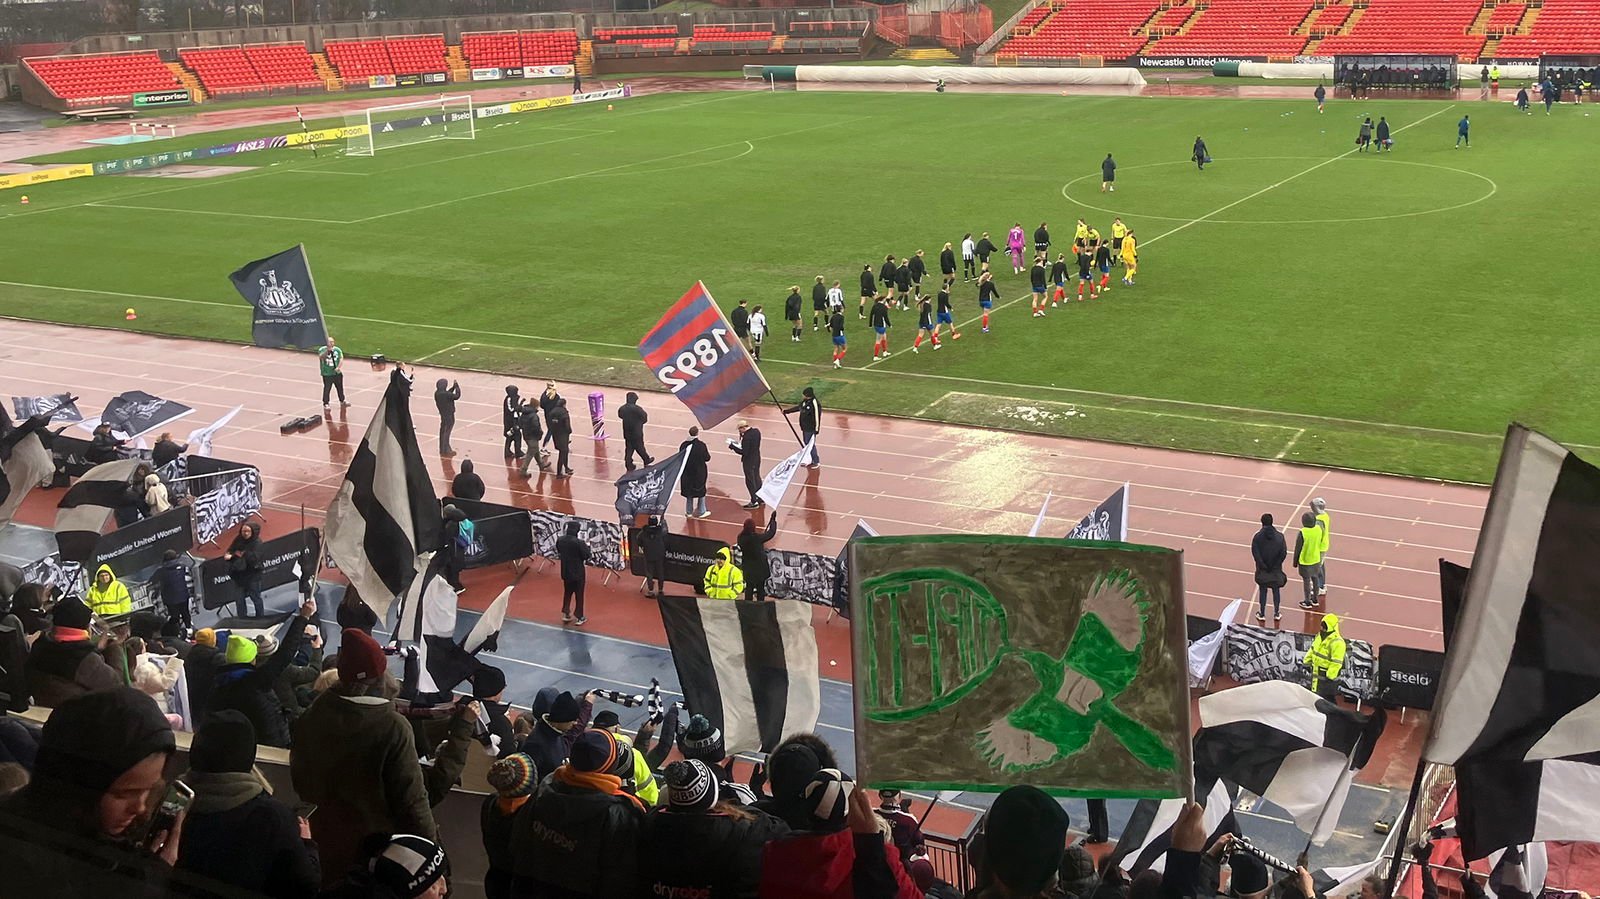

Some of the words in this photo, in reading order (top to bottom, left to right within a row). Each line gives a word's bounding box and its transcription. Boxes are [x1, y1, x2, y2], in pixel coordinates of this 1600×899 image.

[1140, 58, 1185, 67] Newcastle
[1187, 57, 1216, 67] United
[137, 93, 188, 103] enterprise
[158, 154, 169, 162] PIF
[183, 151, 193, 159] PIF
[106, 162, 118, 170] PIF
[132, 159, 144, 167] PIF
[96, 543, 133, 563] Newcastle
[133, 533, 156, 548] United
[156, 525, 183, 540] Women
[281, 547, 310, 563] Womn
[673, 551, 695, 562] United
[696, 555, 716, 565] Wom
[1402, 673, 1429, 686] sela
[532, 820, 577, 852] dryrobe
[653, 881, 710, 899] dryrobe
